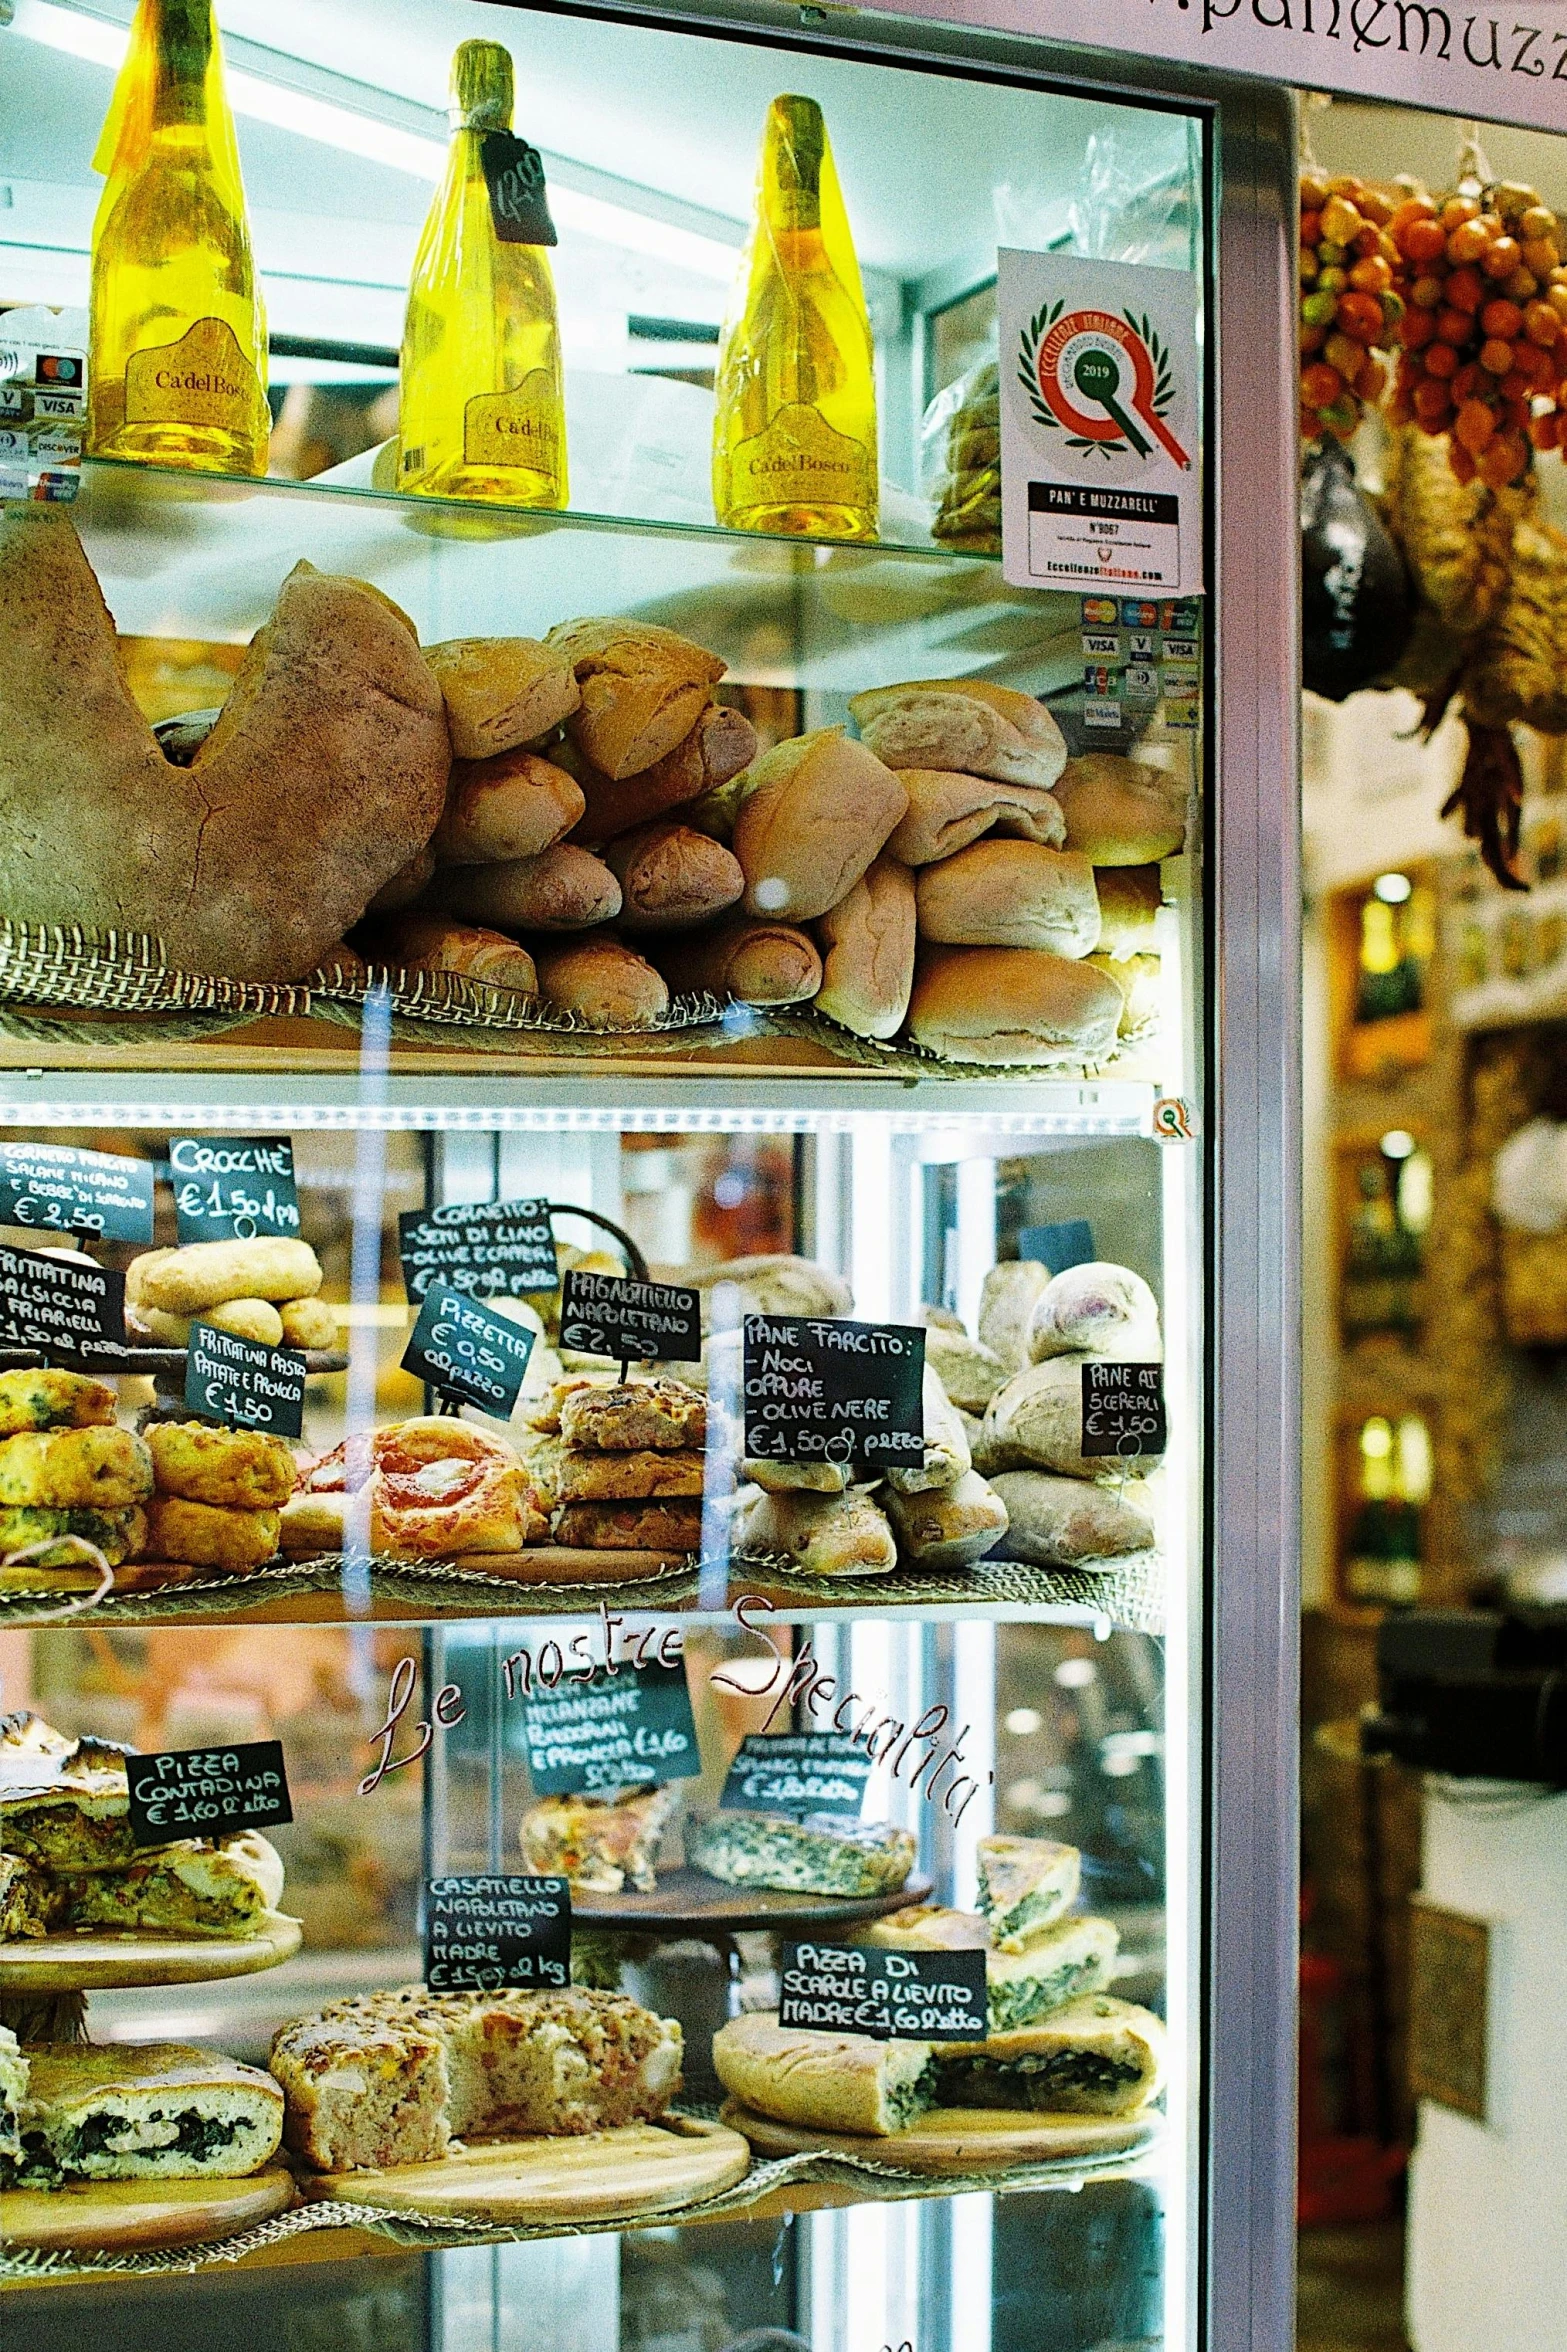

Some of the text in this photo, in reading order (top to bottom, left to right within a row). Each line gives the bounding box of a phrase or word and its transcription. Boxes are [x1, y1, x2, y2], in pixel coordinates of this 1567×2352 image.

[1082, 365, 1110, 378] 2019
[43, 398, 76, 415] VISA
[38, 442, 80, 454] DISCOVER
[1049, 489, 1159, 514] PAN' E MUZZARELL'
[1087, 639, 1116, 652] VISA
[1168, 643, 1194, 656] VISA
[6, 1160, 129, 1190] SALAME MILANO
[10, 1178, 22, 1191] E
[465, 1226, 491, 1244] DI
[494, 1224, 551, 1244] LINO
[0, 1249, 107, 1297] RITTATINA
[0, 1276, 97, 1314] ALSICCIA
[7, 1296, 104, 1333] FRIARIELLI
[566, 1300, 690, 1335] NAPOLETANO
[0, 1319, 52, 1346] 1,50
[439, 1297, 528, 1360] PIZZETTA
[744, 1314, 800, 1347] PANE
[198, 1327, 307, 1378] FRITTATINA PASTA
[193, 1349, 302, 1402] PATATE E PROVOLA
[745, 1372, 824, 1399] OPPURE
[1089, 1363, 1159, 1390] PANE AI
[830, 1398, 892, 1421] NERE
[356, 1656, 467, 1796] Le
[501, 1600, 684, 1699] nostre
[154, 1752, 240, 1780] PIZZA
[531, 1749, 547, 1771] E
[134, 1770, 282, 1803] CONTADINA
[435, 1897, 560, 1918] NAPOLETANO
[432, 1920, 532, 1939] A LIEVITO
[432, 1941, 502, 1962] MADRE
[796, 1944, 920, 1978] PIZZA DI
[537, 1954, 567, 1986] kg
[783, 1969, 973, 2006] SCAROLE A LIEVITO
[783, 1998, 855, 2025] MADRE
